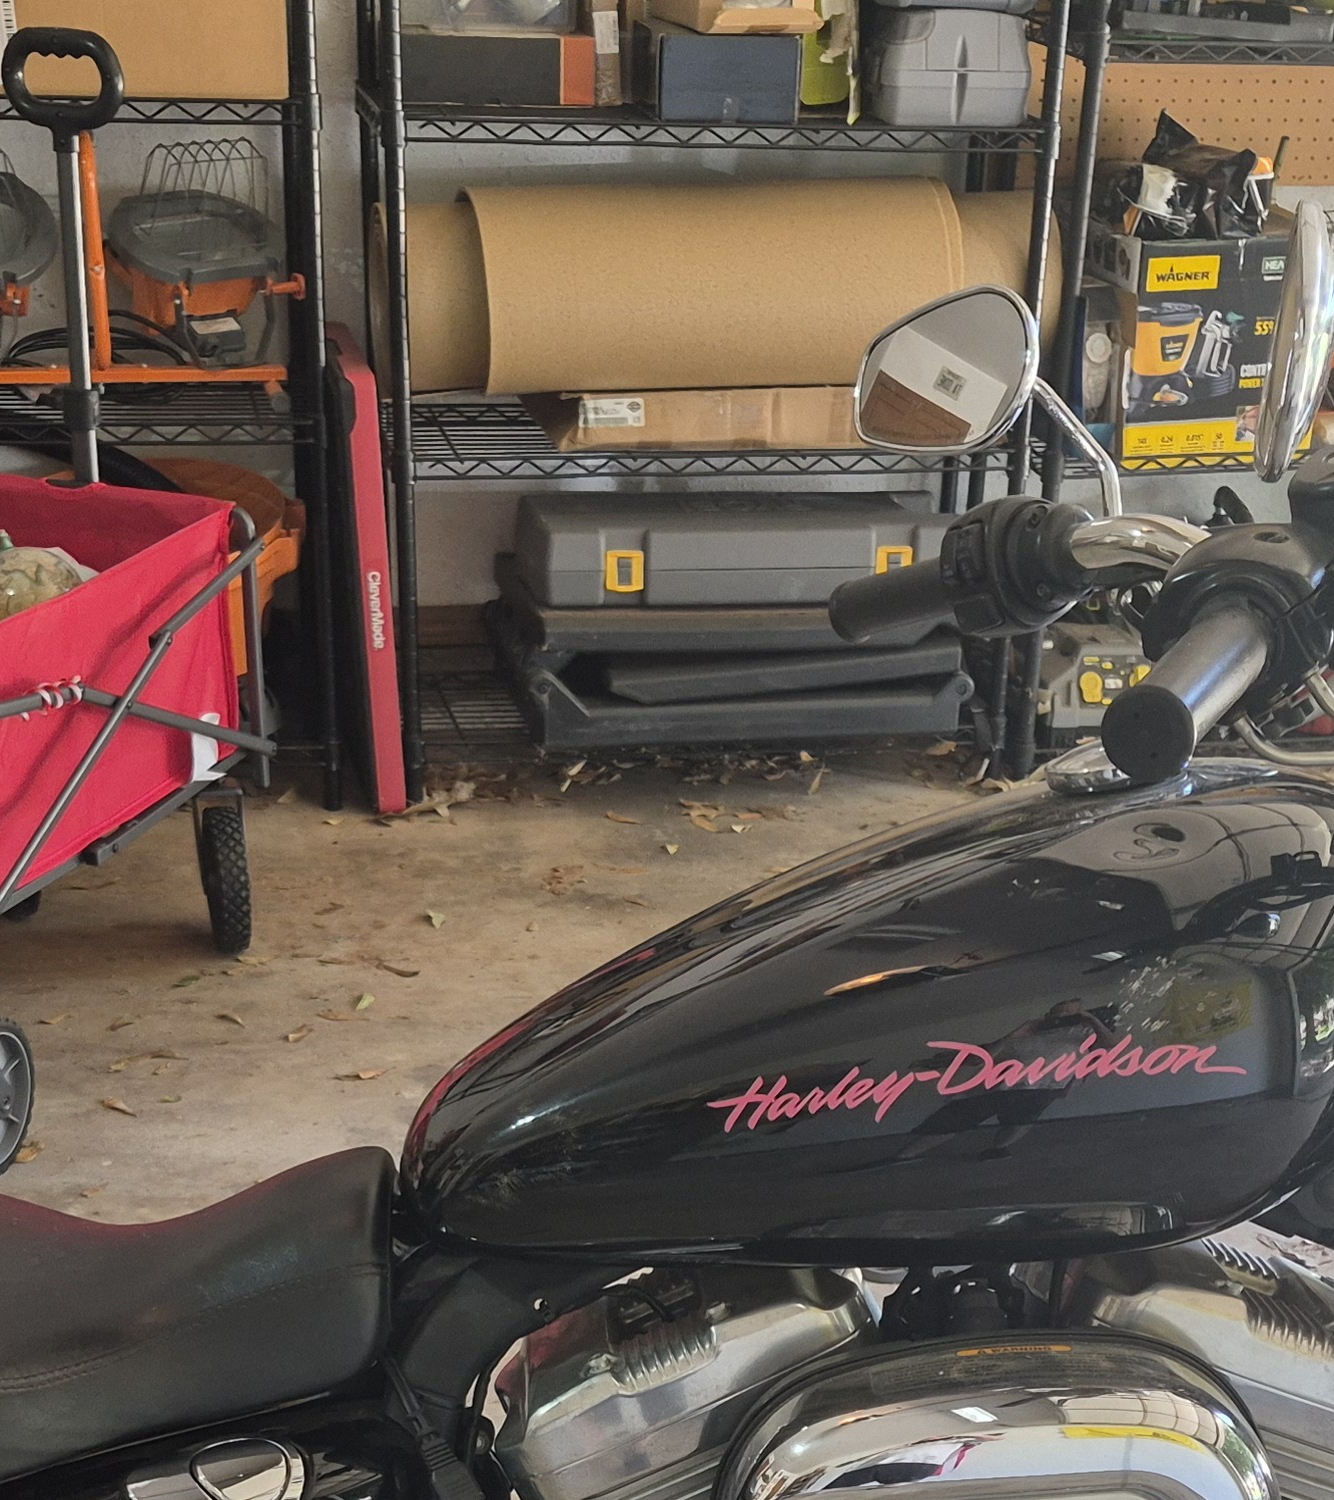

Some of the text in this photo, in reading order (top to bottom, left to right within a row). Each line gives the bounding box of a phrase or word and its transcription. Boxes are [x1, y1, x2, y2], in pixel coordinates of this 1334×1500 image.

[1155, 269, 1210, 283] WAGNER
[368, 571, 386, 649] CleverMade
[707, 1033, 1247, 1133] Harley-Davidson
